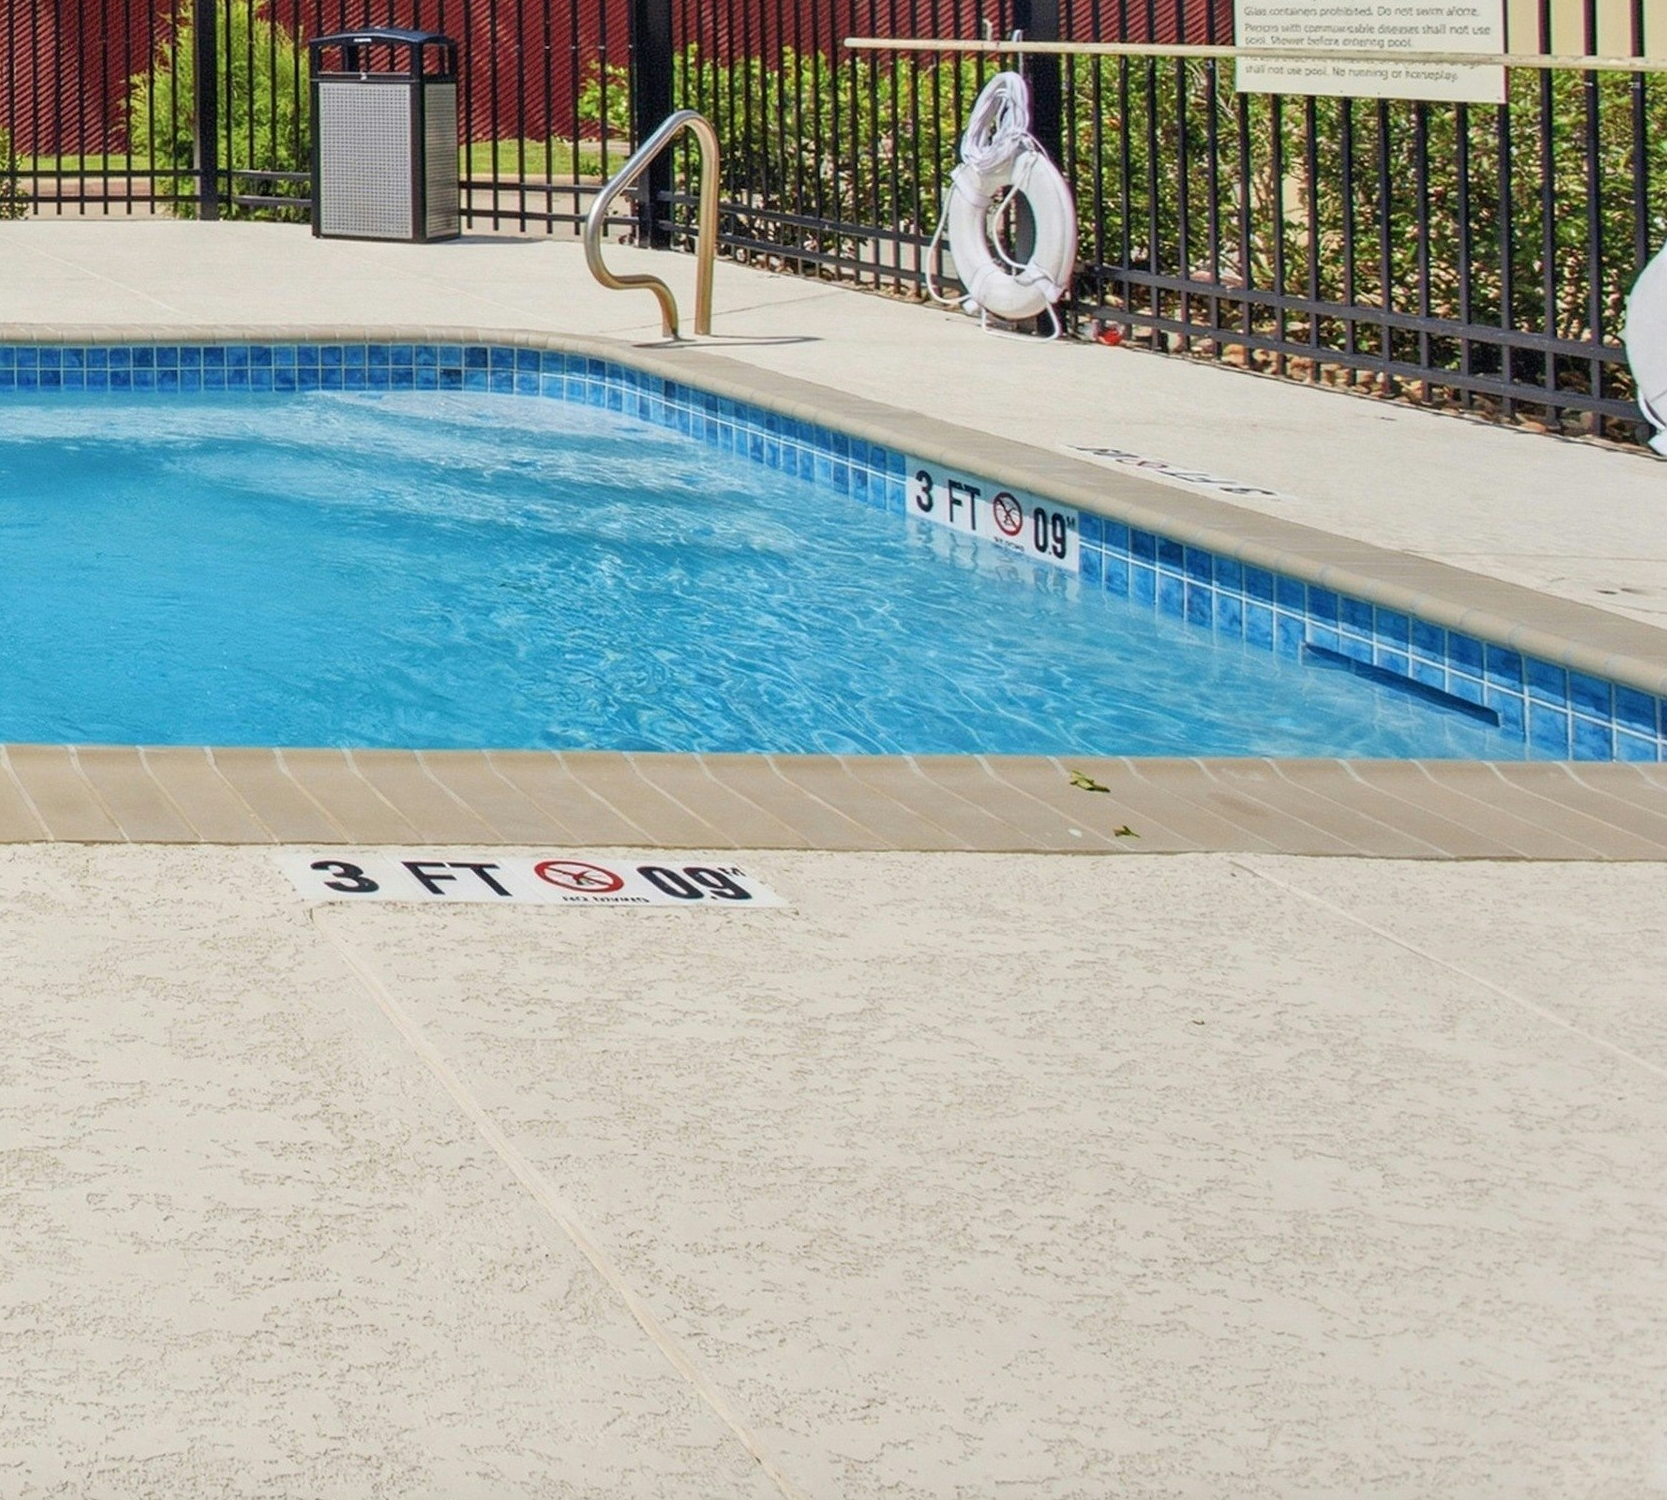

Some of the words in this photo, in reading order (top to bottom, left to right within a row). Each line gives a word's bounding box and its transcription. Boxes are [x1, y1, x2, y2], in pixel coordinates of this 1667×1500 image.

[1376, 5, 1391, 16] Do
[1394, 5, 1413, 16] not
[1421, 23, 1446, 35] shall
[1448, 23, 1469, 35] not
[1472, 26, 1491, 35] use
[1307, 36, 1339, 46] before
[1267, 65, 1283, 75] not
[1286, 67, 1301, 75] use
[1331, 66, 1345, 77] No
[1348, 67, 1388, 79] running
[916, 470, 933, 513] 3
[948, 479, 981, 530] FT
[310, 860, 380, 893] 3
[401, 861, 513, 897] FT
